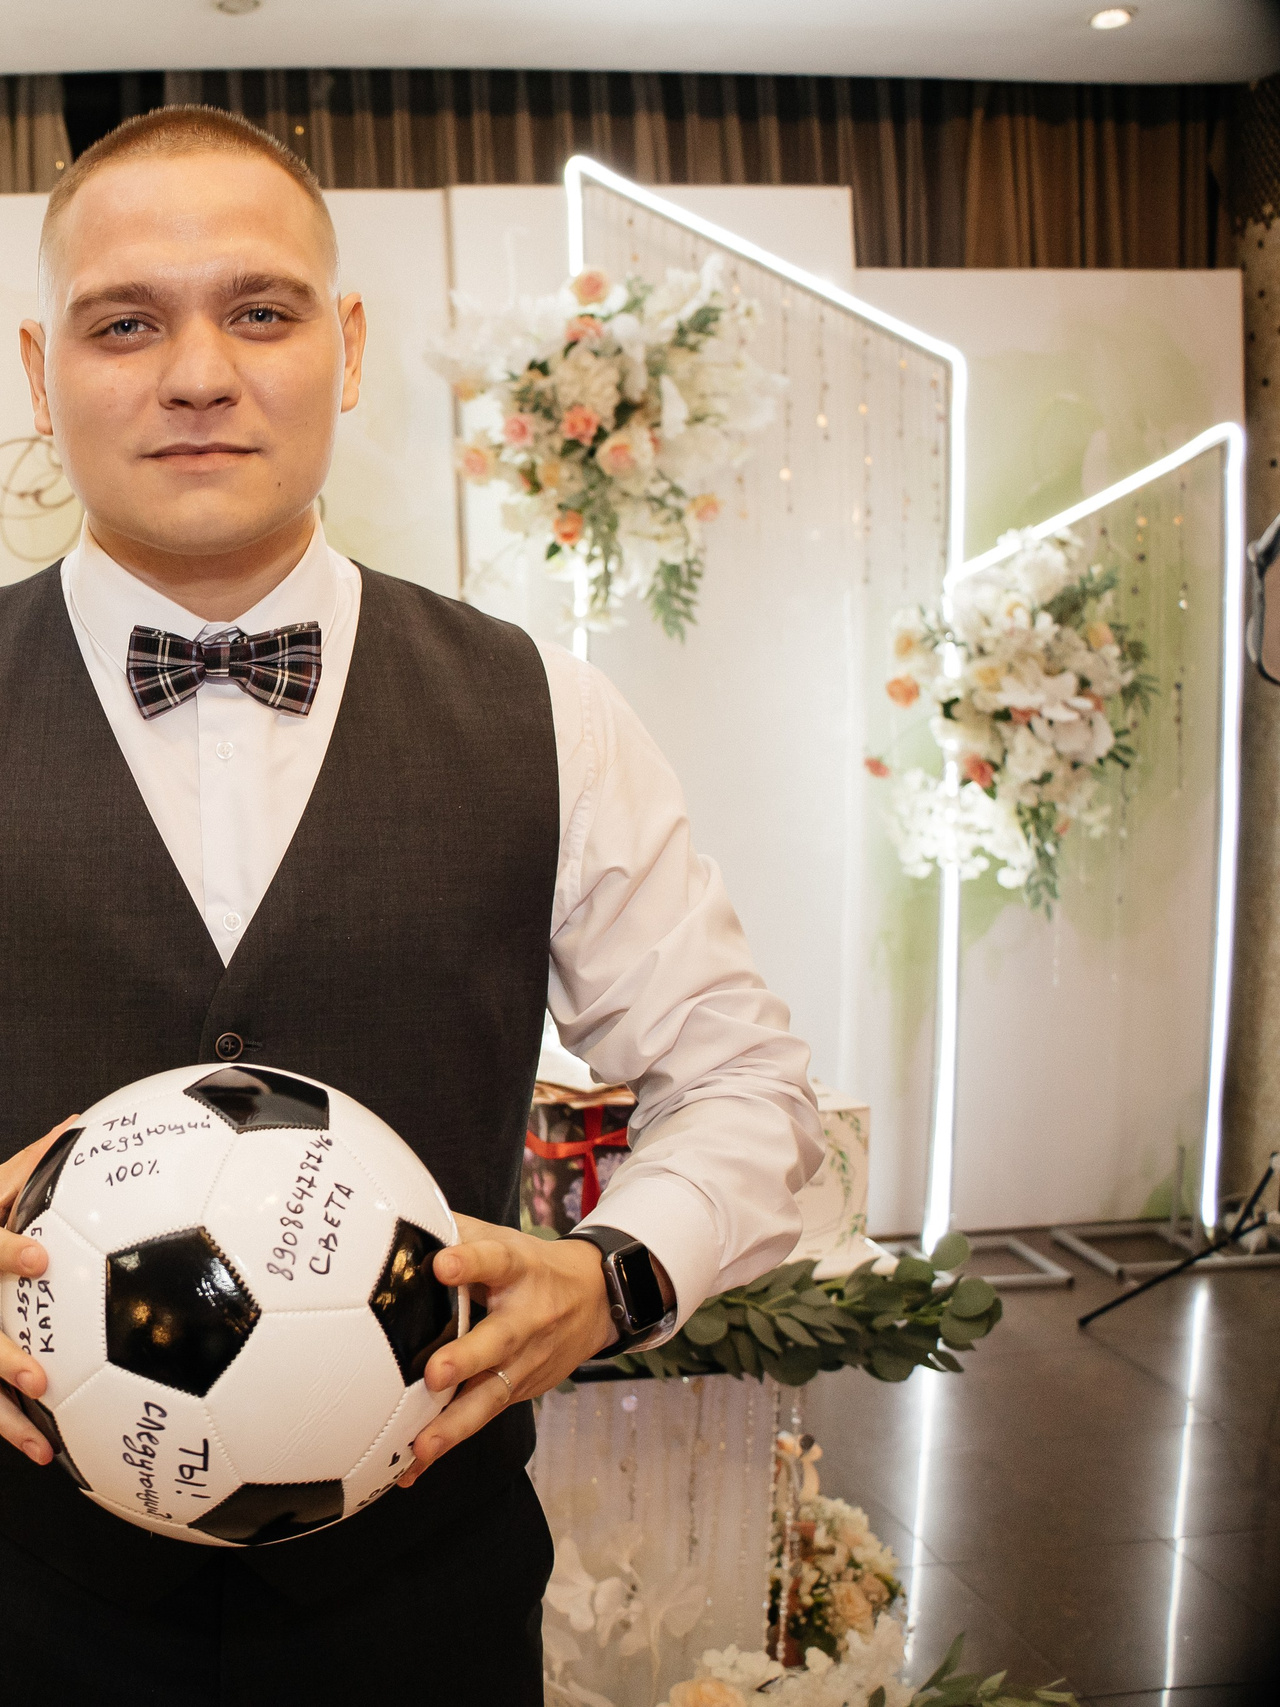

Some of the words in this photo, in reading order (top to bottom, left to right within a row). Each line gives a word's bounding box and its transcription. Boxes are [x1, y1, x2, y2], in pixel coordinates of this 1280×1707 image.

[105, 1159, 161, 1187] 100%
[308, 1182, 355, 1276] СВЕТА
[35, 1279, 56, 1353] КАТЯ
